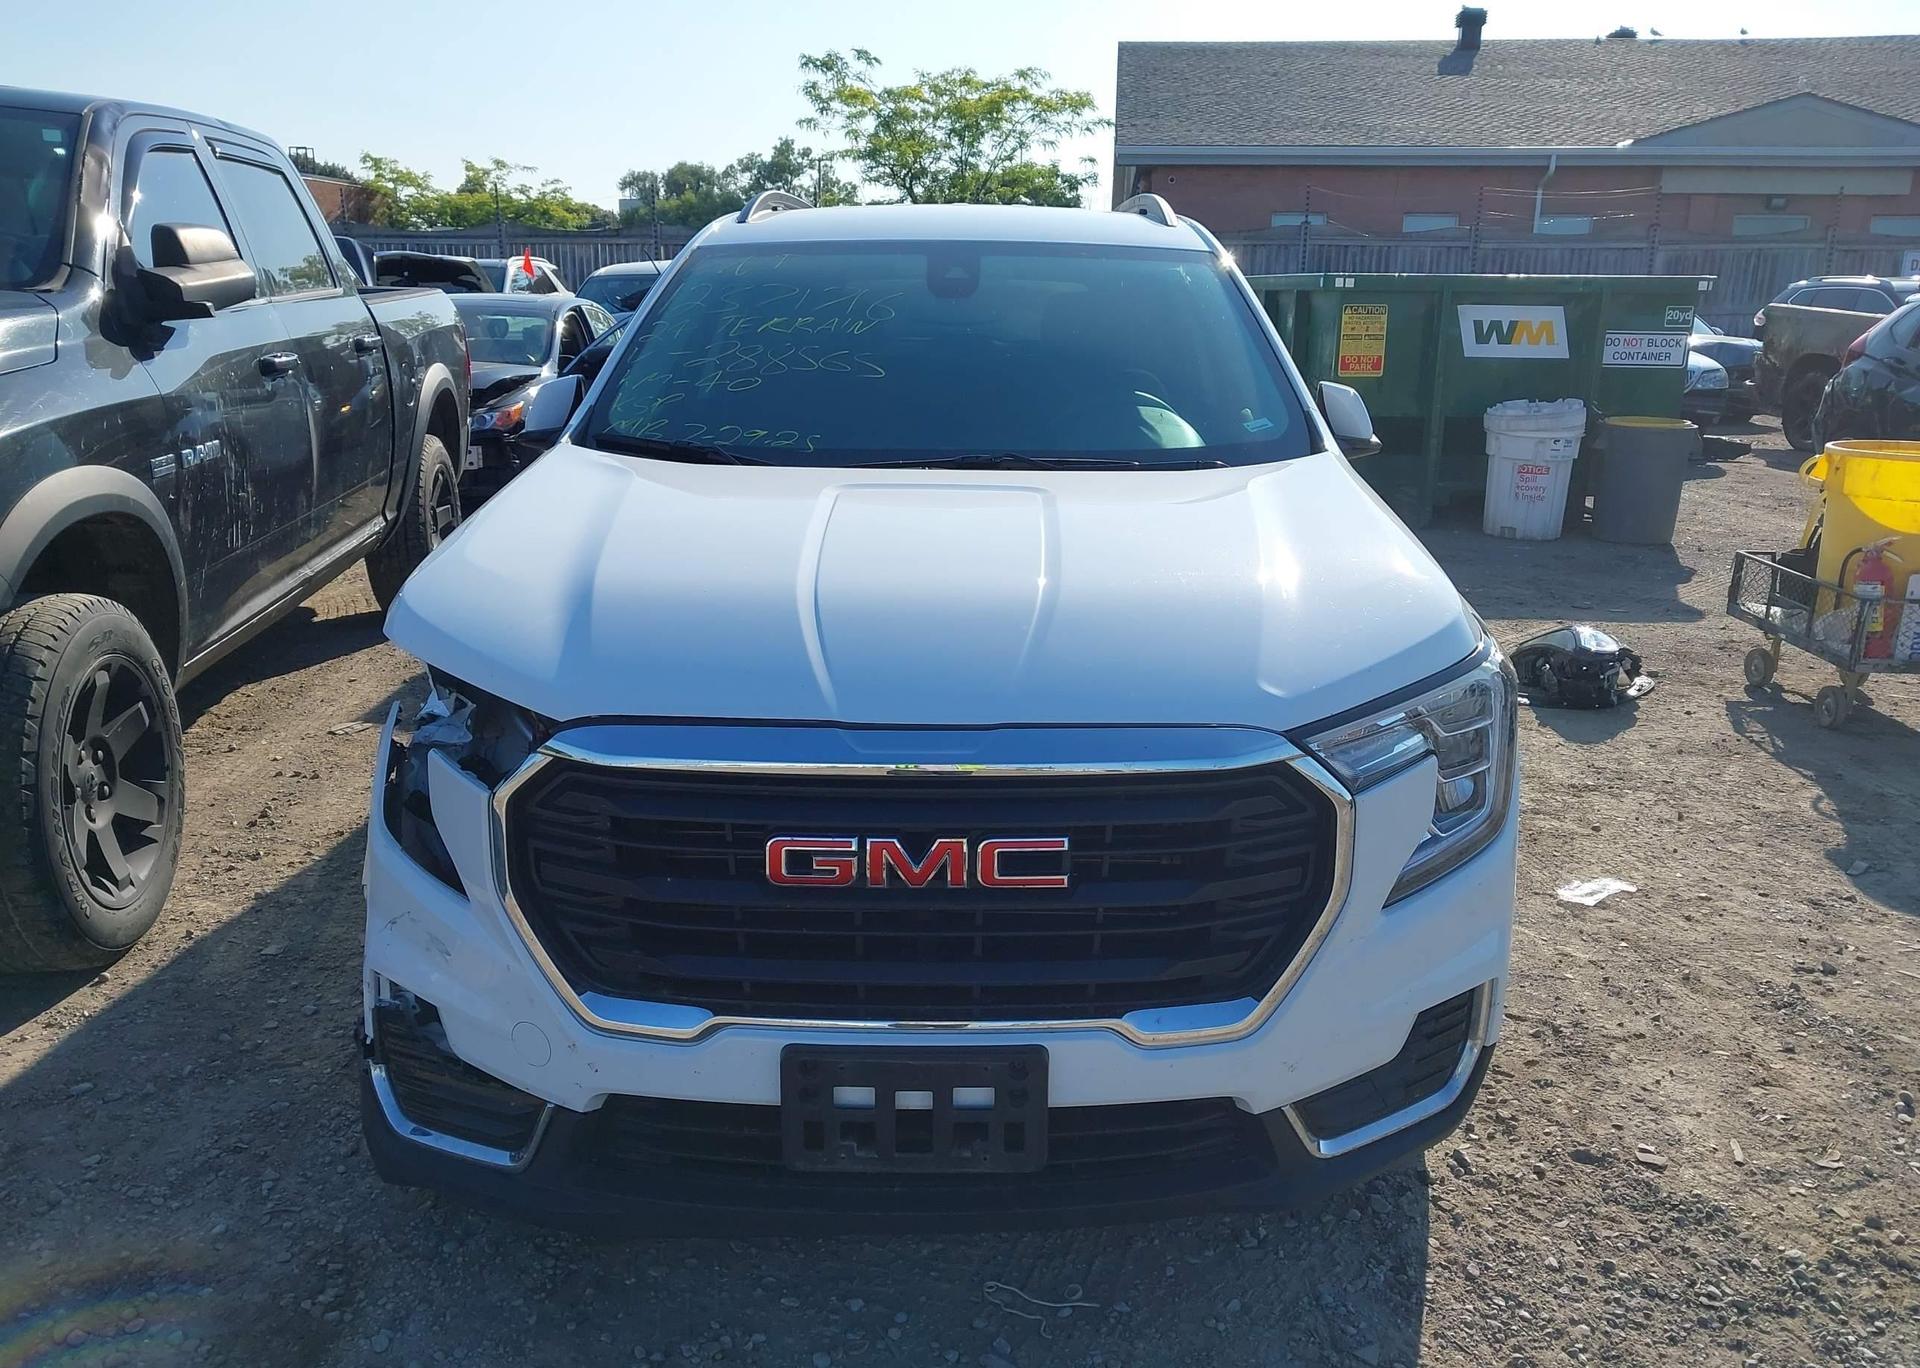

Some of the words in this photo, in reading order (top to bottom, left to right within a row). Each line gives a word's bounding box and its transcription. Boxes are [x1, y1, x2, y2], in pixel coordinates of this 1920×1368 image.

[1352, 306, 1386, 314] CAUTION
[1667, 309, 1692, 322] 20yd
[1473, 319, 1556, 346] WM
[1605, 337, 1621, 347] DO
[1623, 337, 1645, 347] NOT
[1647, 338, 1682, 348] BLOCK
[1345, 356, 1358, 364] DO
[1360, 356, 1378, 364] NOT
[1612, 351, 1672, 361] CONTAINER
[1349, 363, 1373, 371] PARK
[765, 836, 1069, 888] GMC
